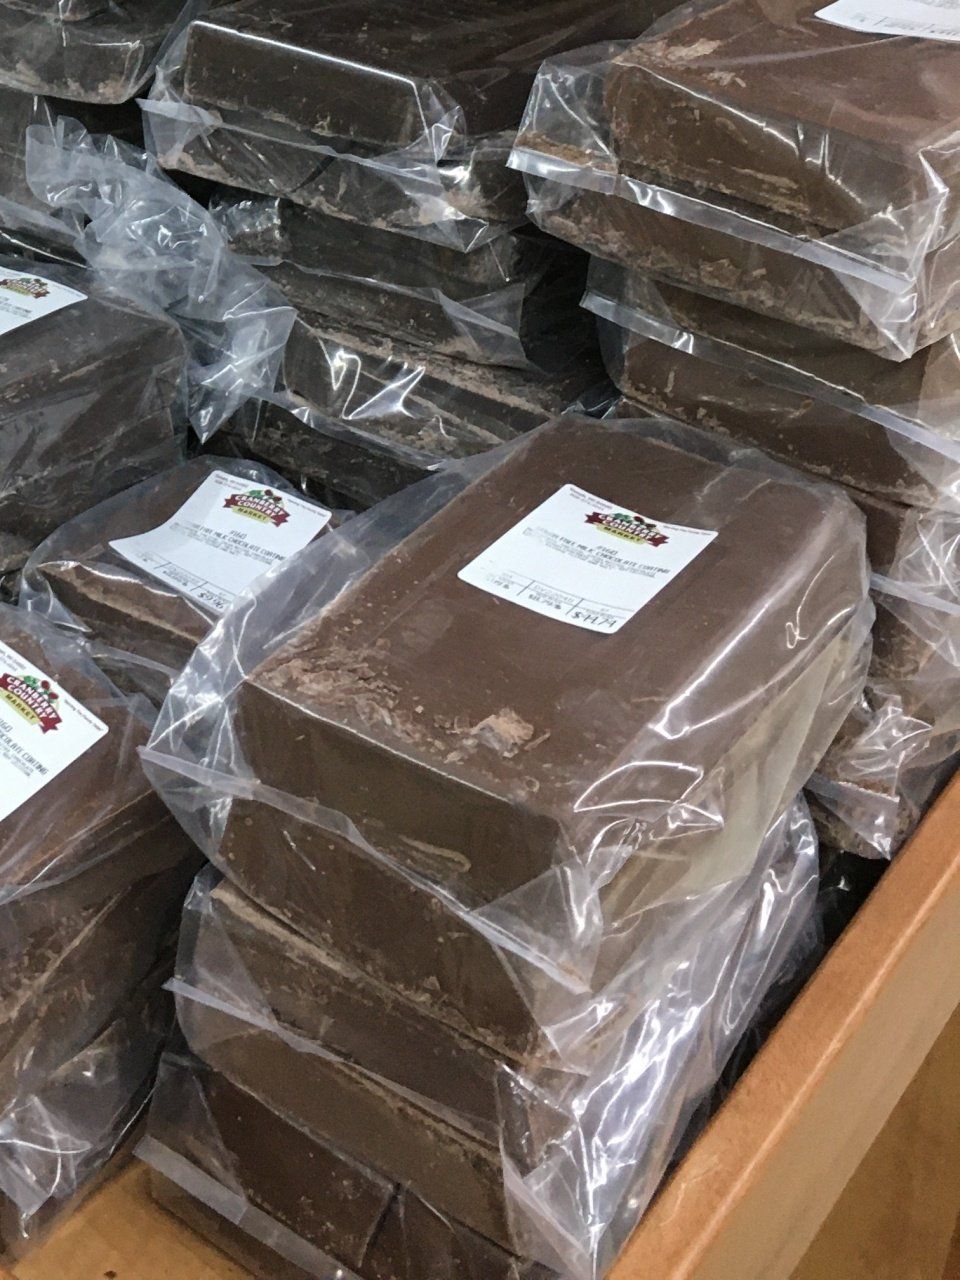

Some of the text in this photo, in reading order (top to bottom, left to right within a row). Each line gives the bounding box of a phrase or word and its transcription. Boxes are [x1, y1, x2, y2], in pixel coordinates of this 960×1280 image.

[234, 495, 285, 516] CRANBERRY
[237, 501, 276, 518] COUNTRY
[259, 547, 286, 562] COATIN
[4, 693, 37, 722] MARKET
[5, 675, 59, 721] CRANBERRY
[6, 684, 48, 722] COUNTRY
[19, 751, 49, 776] COATING
